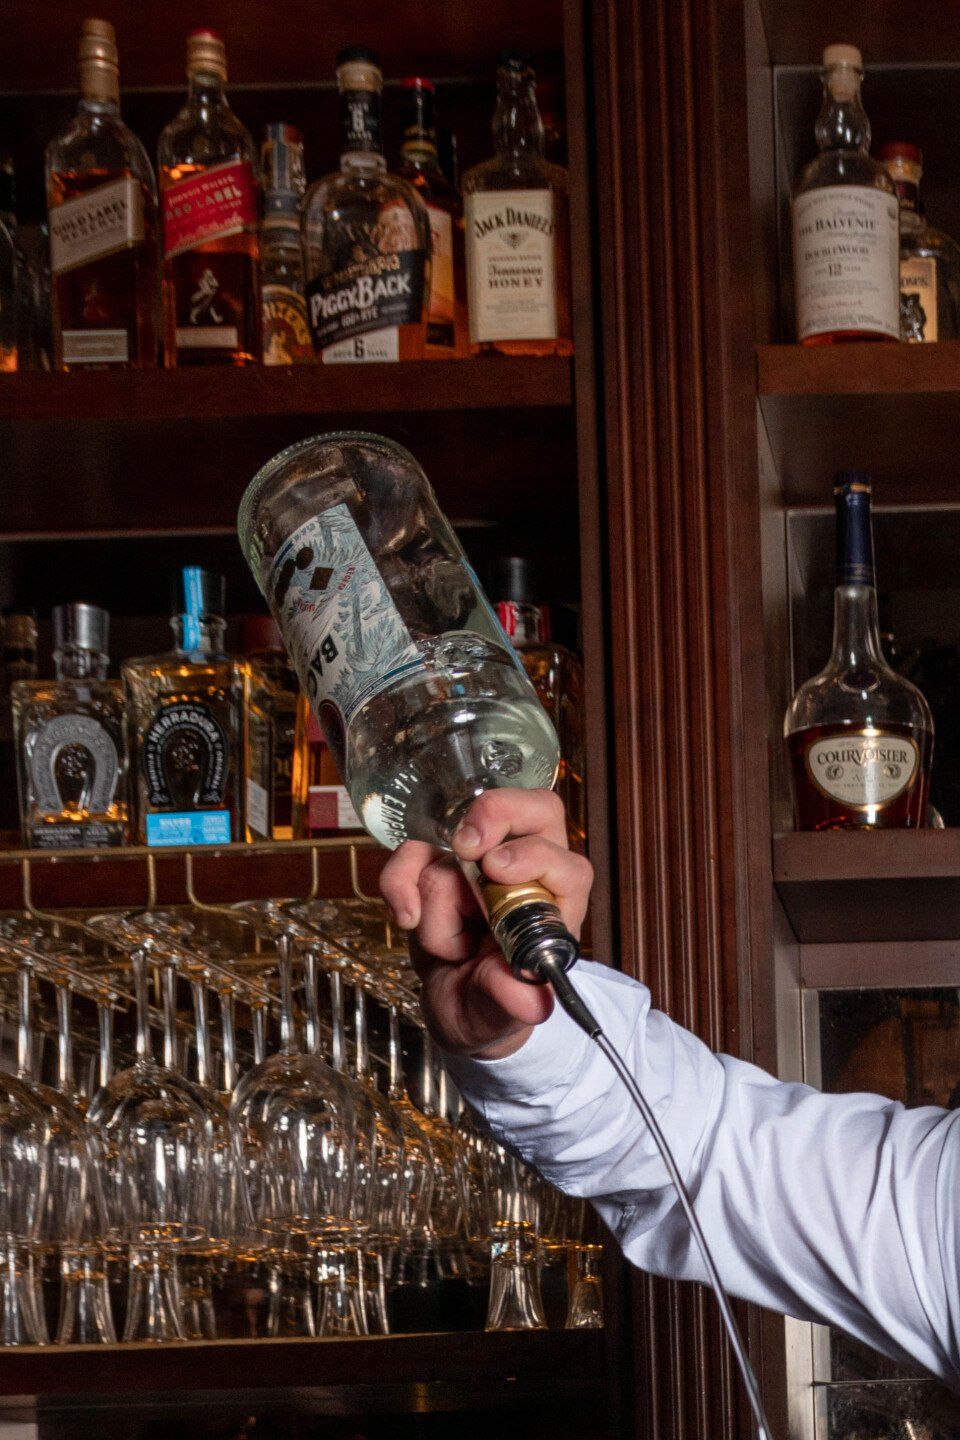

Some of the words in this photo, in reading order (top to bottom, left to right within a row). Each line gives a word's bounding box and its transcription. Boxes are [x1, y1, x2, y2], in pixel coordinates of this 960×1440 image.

[198, 184, 244, 210] LABEL
[475, 211, 505, 239] JACK
[815, 217, 876, 232] BALVENIE
[827, 263, 842, 277] 12
[488, 277, 544, 289] HONEY
[149, 710, 220, 744] HERRADURA
[817, 748, 908, 767] COURVOISIER
